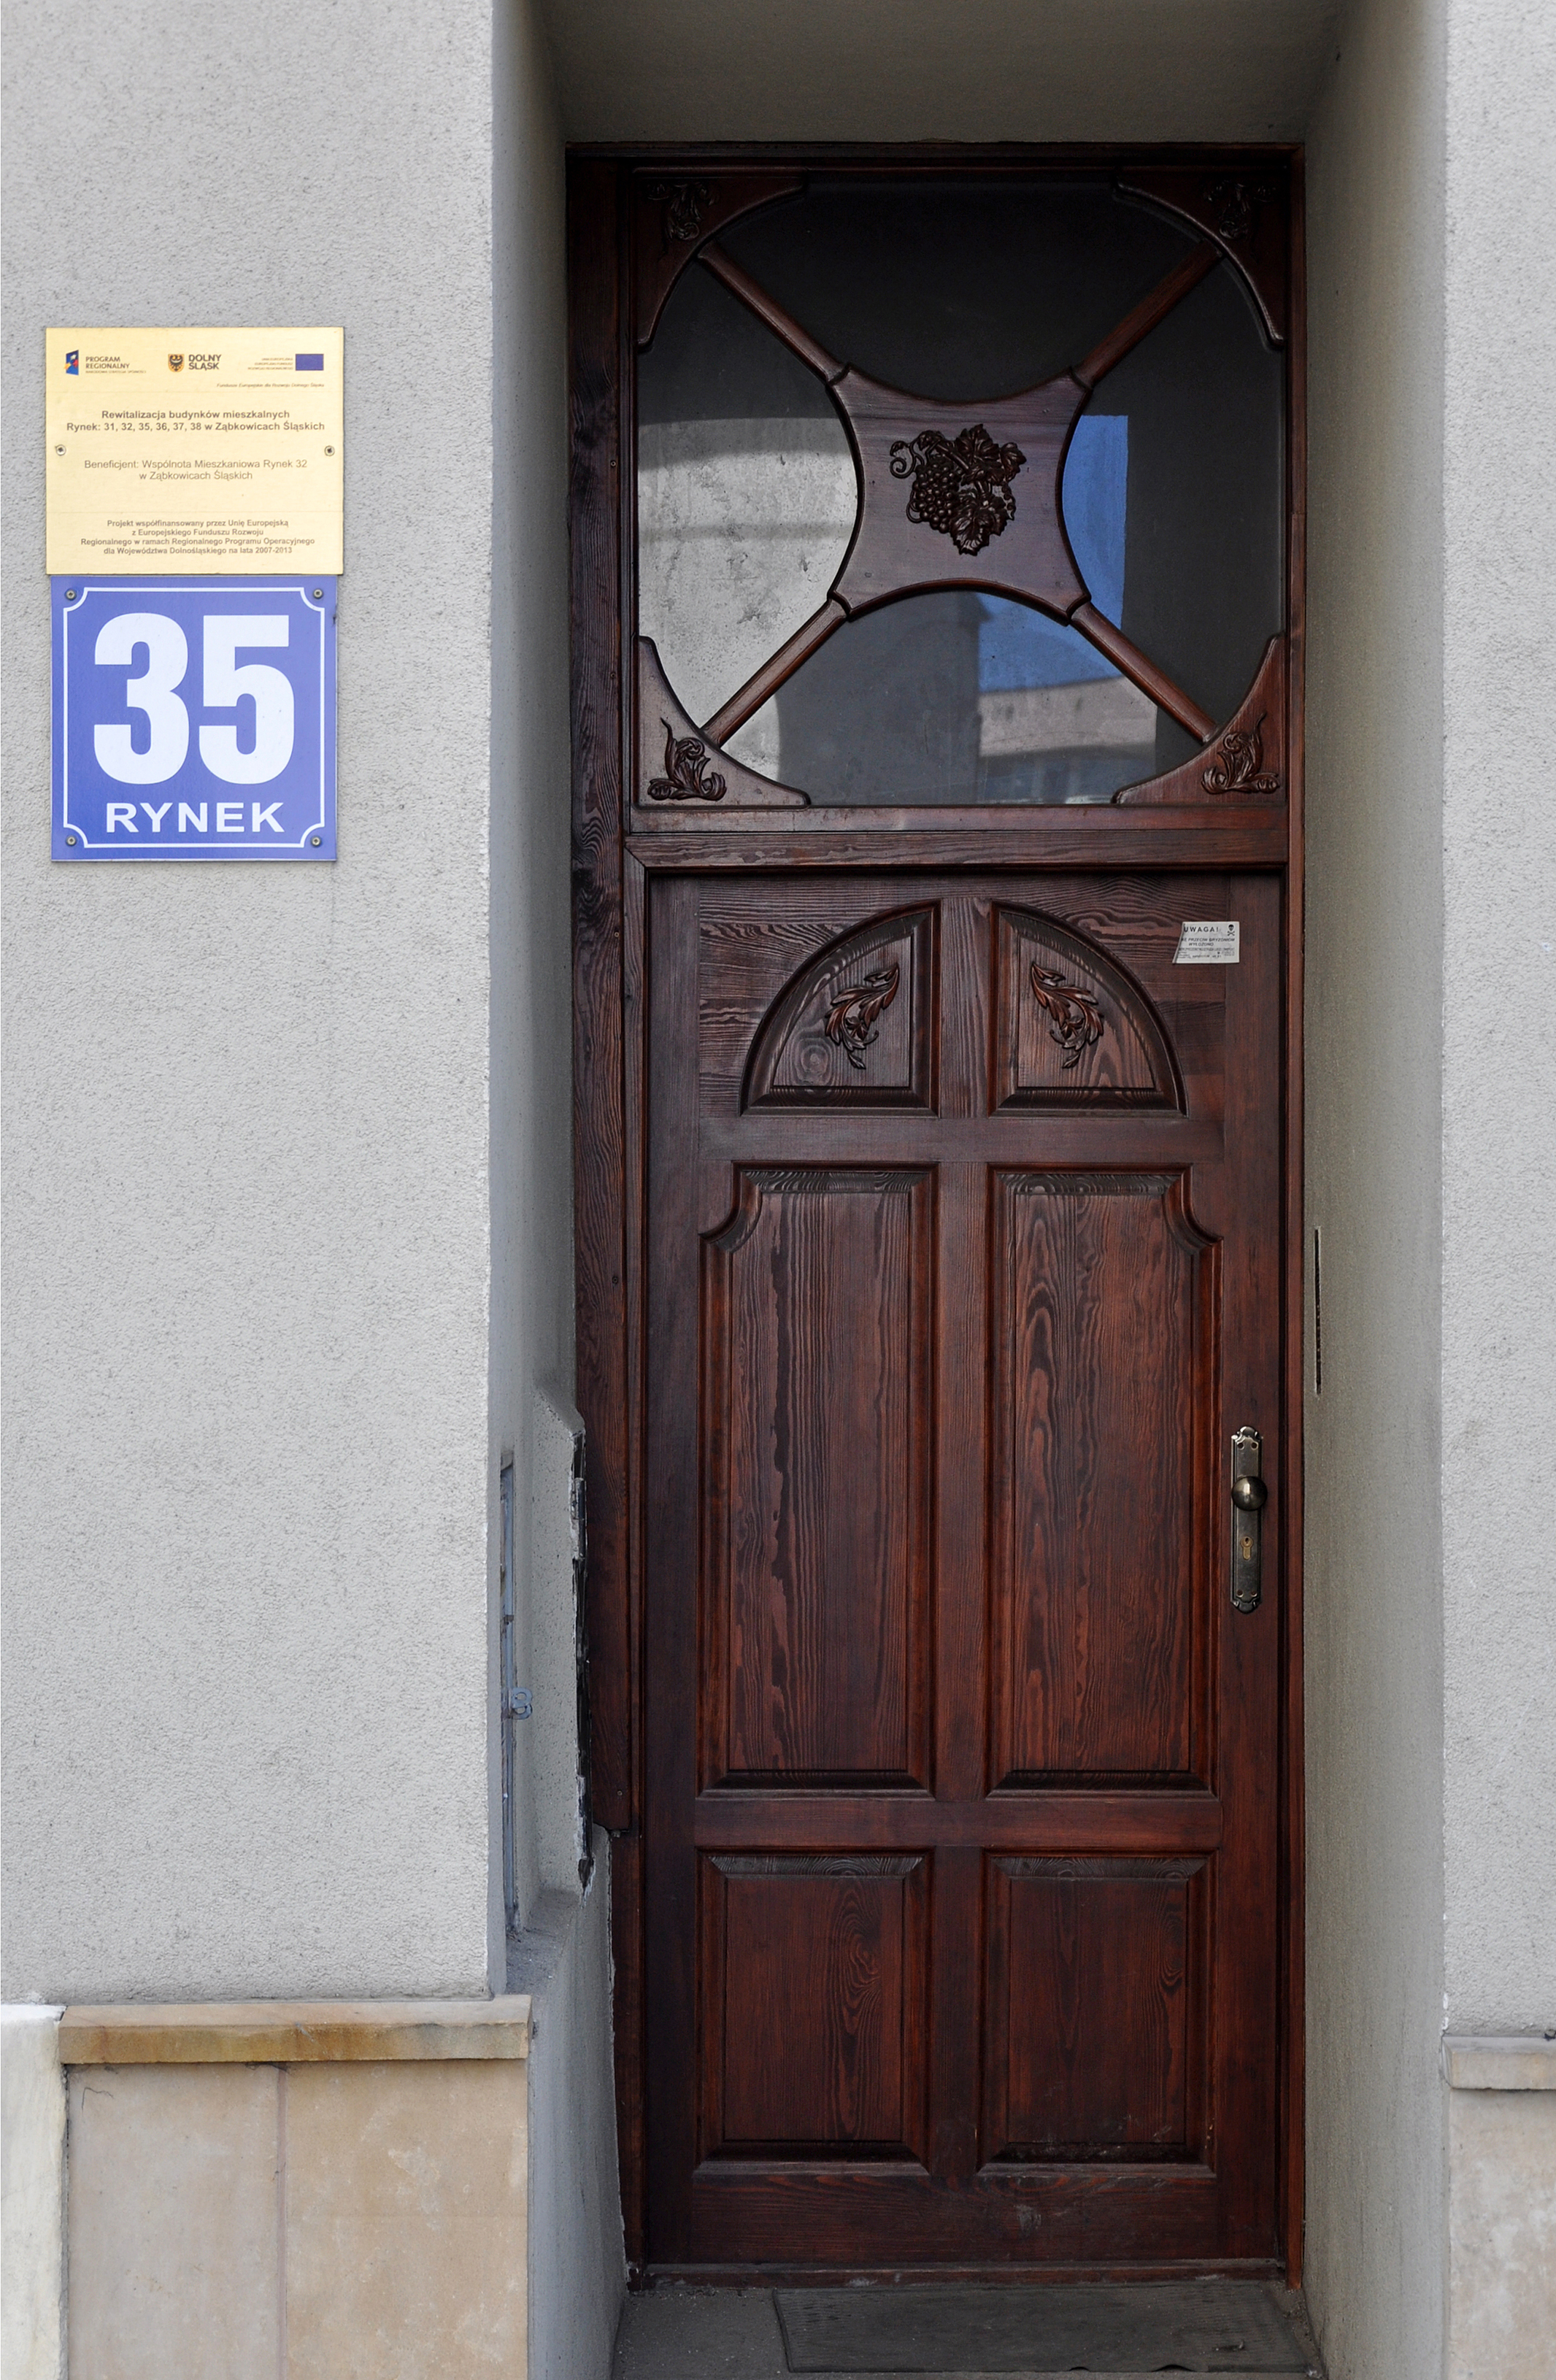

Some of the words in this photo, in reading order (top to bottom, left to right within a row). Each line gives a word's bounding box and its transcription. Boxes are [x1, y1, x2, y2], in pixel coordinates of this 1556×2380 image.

[188, 354, 222, 362] DOLNY
[188, 361, 220, 371] ŚLĄSK
[101, 410, 166, 420] Rewitalizacja
[169, 410, 220, 420] budynków
[223, 410, 290, 420] mieszkalnych
[66, 422, 101, 433] Rynek:
[104, 422, 118, 432] 31,
[121, 422, 136, 432] 32,
[138, 422, 153, 432] 35,
[155, 422, 170, 432] 36,
[173, 422, 188, 432] 37,
[190, 422, 201, 431] 38
[215, 422, 280, 432] Ząbkowicach
[283, 421, 325, 432] Śląskich
[85, 460, 139, 471] Beneficjent:
[142, 460, 191, 469] Wspólnota
[194, 460, 260, 468] Mieszkaniowa
[263, 459, 293, 469] Rynek
[296, 459, 307, 468] 32
[150, 471, 210, 481] Ząbkowicach
[214, 469, 253, 481] Śląskich
[107, 520, 134, 528] Projekt
[136, 519, 204, 528] współfinansowany
[228, 519, 244, 527] Unię
[247, 519, 289, 528] Europejską
[138, 528, 191, 536] Europejskiego
[231, 528, 264, 536] Rozwoju
[80, 538, 132, 546] Regionalnego
[172, 538, 223, 546] Regionalnego
[225, 538, 261, 546] Programu
[263, 537, 315, 546] Operacyjnego
[117, 547, 168, 555] Województwa
[169, 547, 226, 555] Dolnośląskiego
[94, 613, 295, 785] 35
[106, 803, 285, 833] RYNEK
